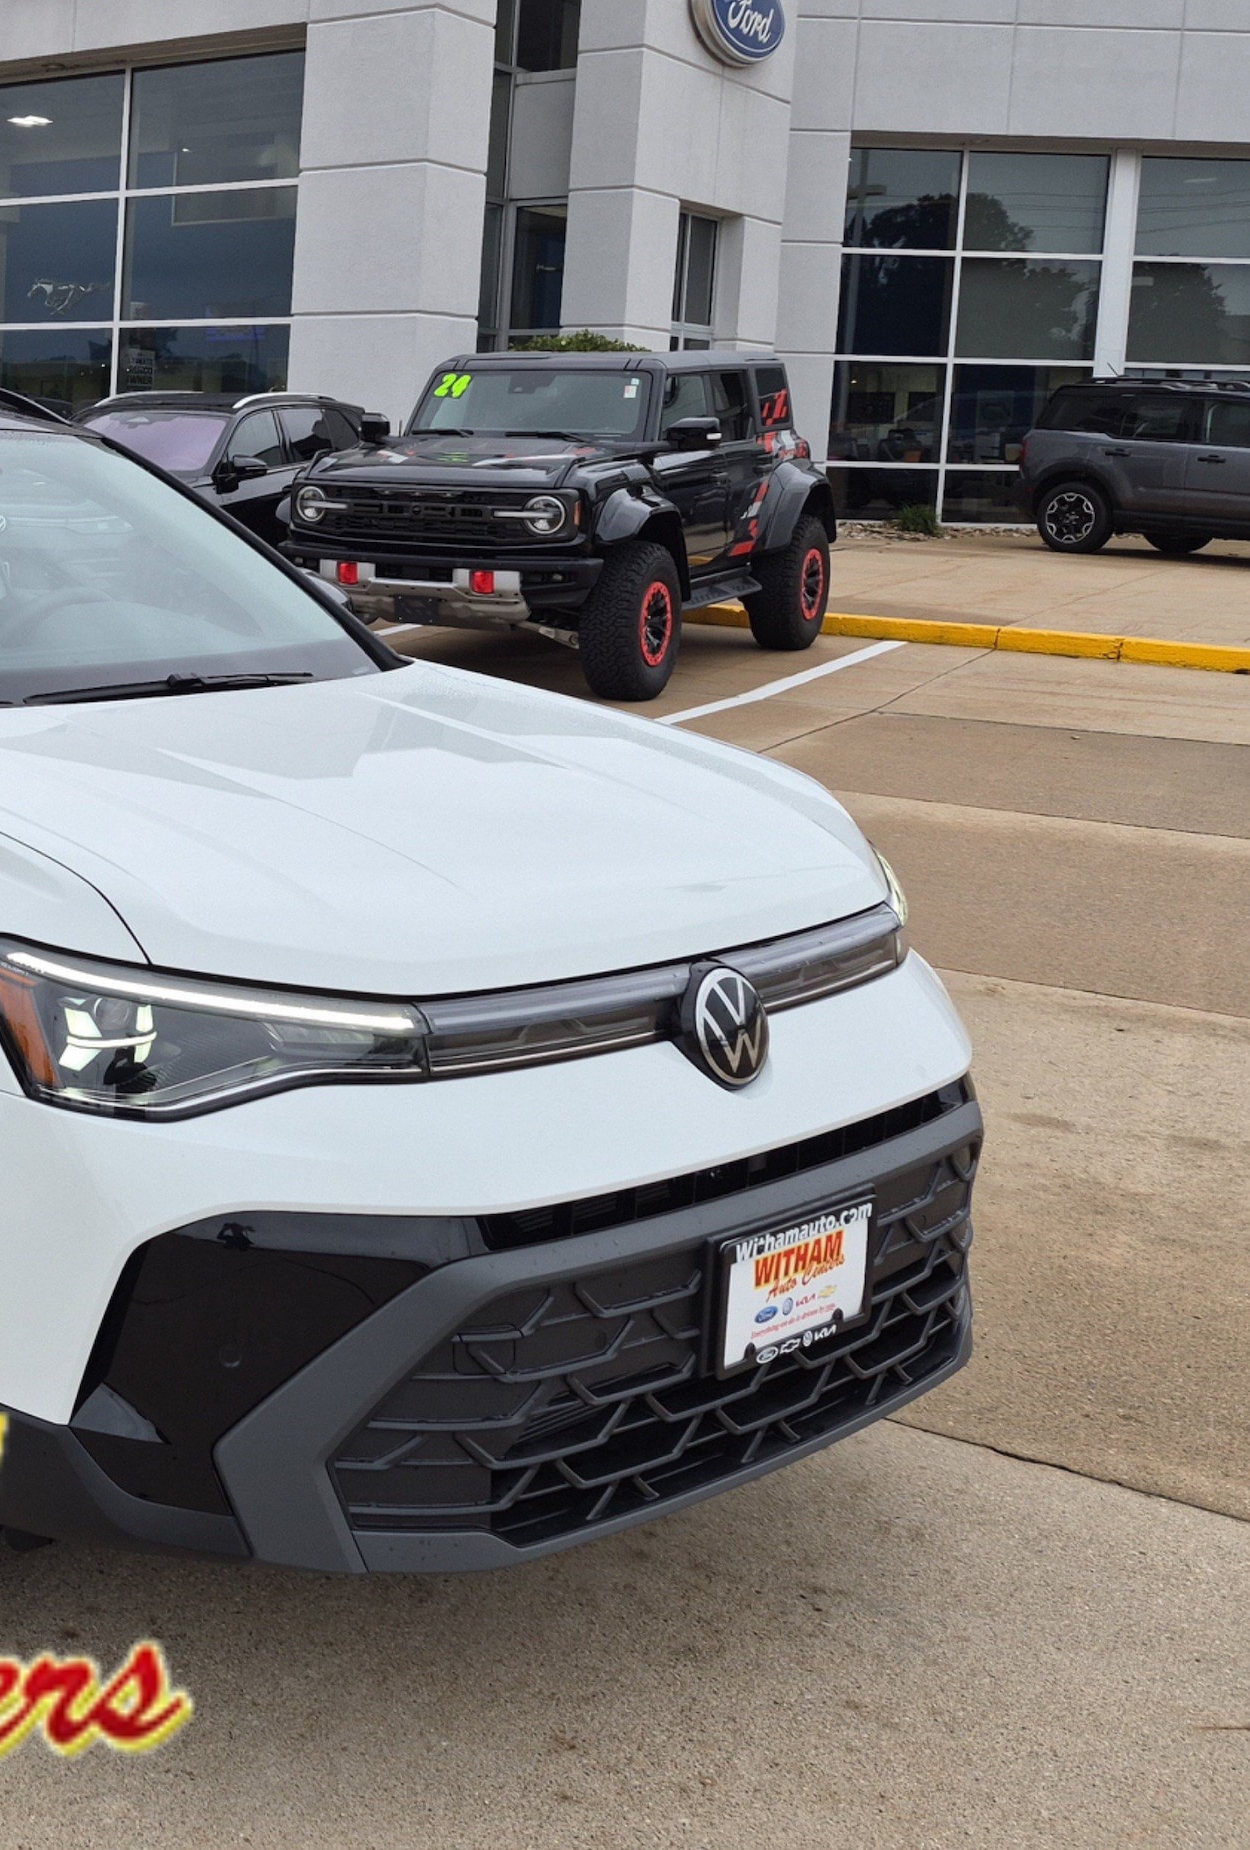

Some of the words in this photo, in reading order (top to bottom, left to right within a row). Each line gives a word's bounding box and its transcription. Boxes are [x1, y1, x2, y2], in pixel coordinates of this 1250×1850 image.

[726, 0, 776, 44] Ford
[433, 372, 472, 399] 24
[754, 1229, 845, 1289] WITHAM
[766, 1275, 798, 1302] Auto
